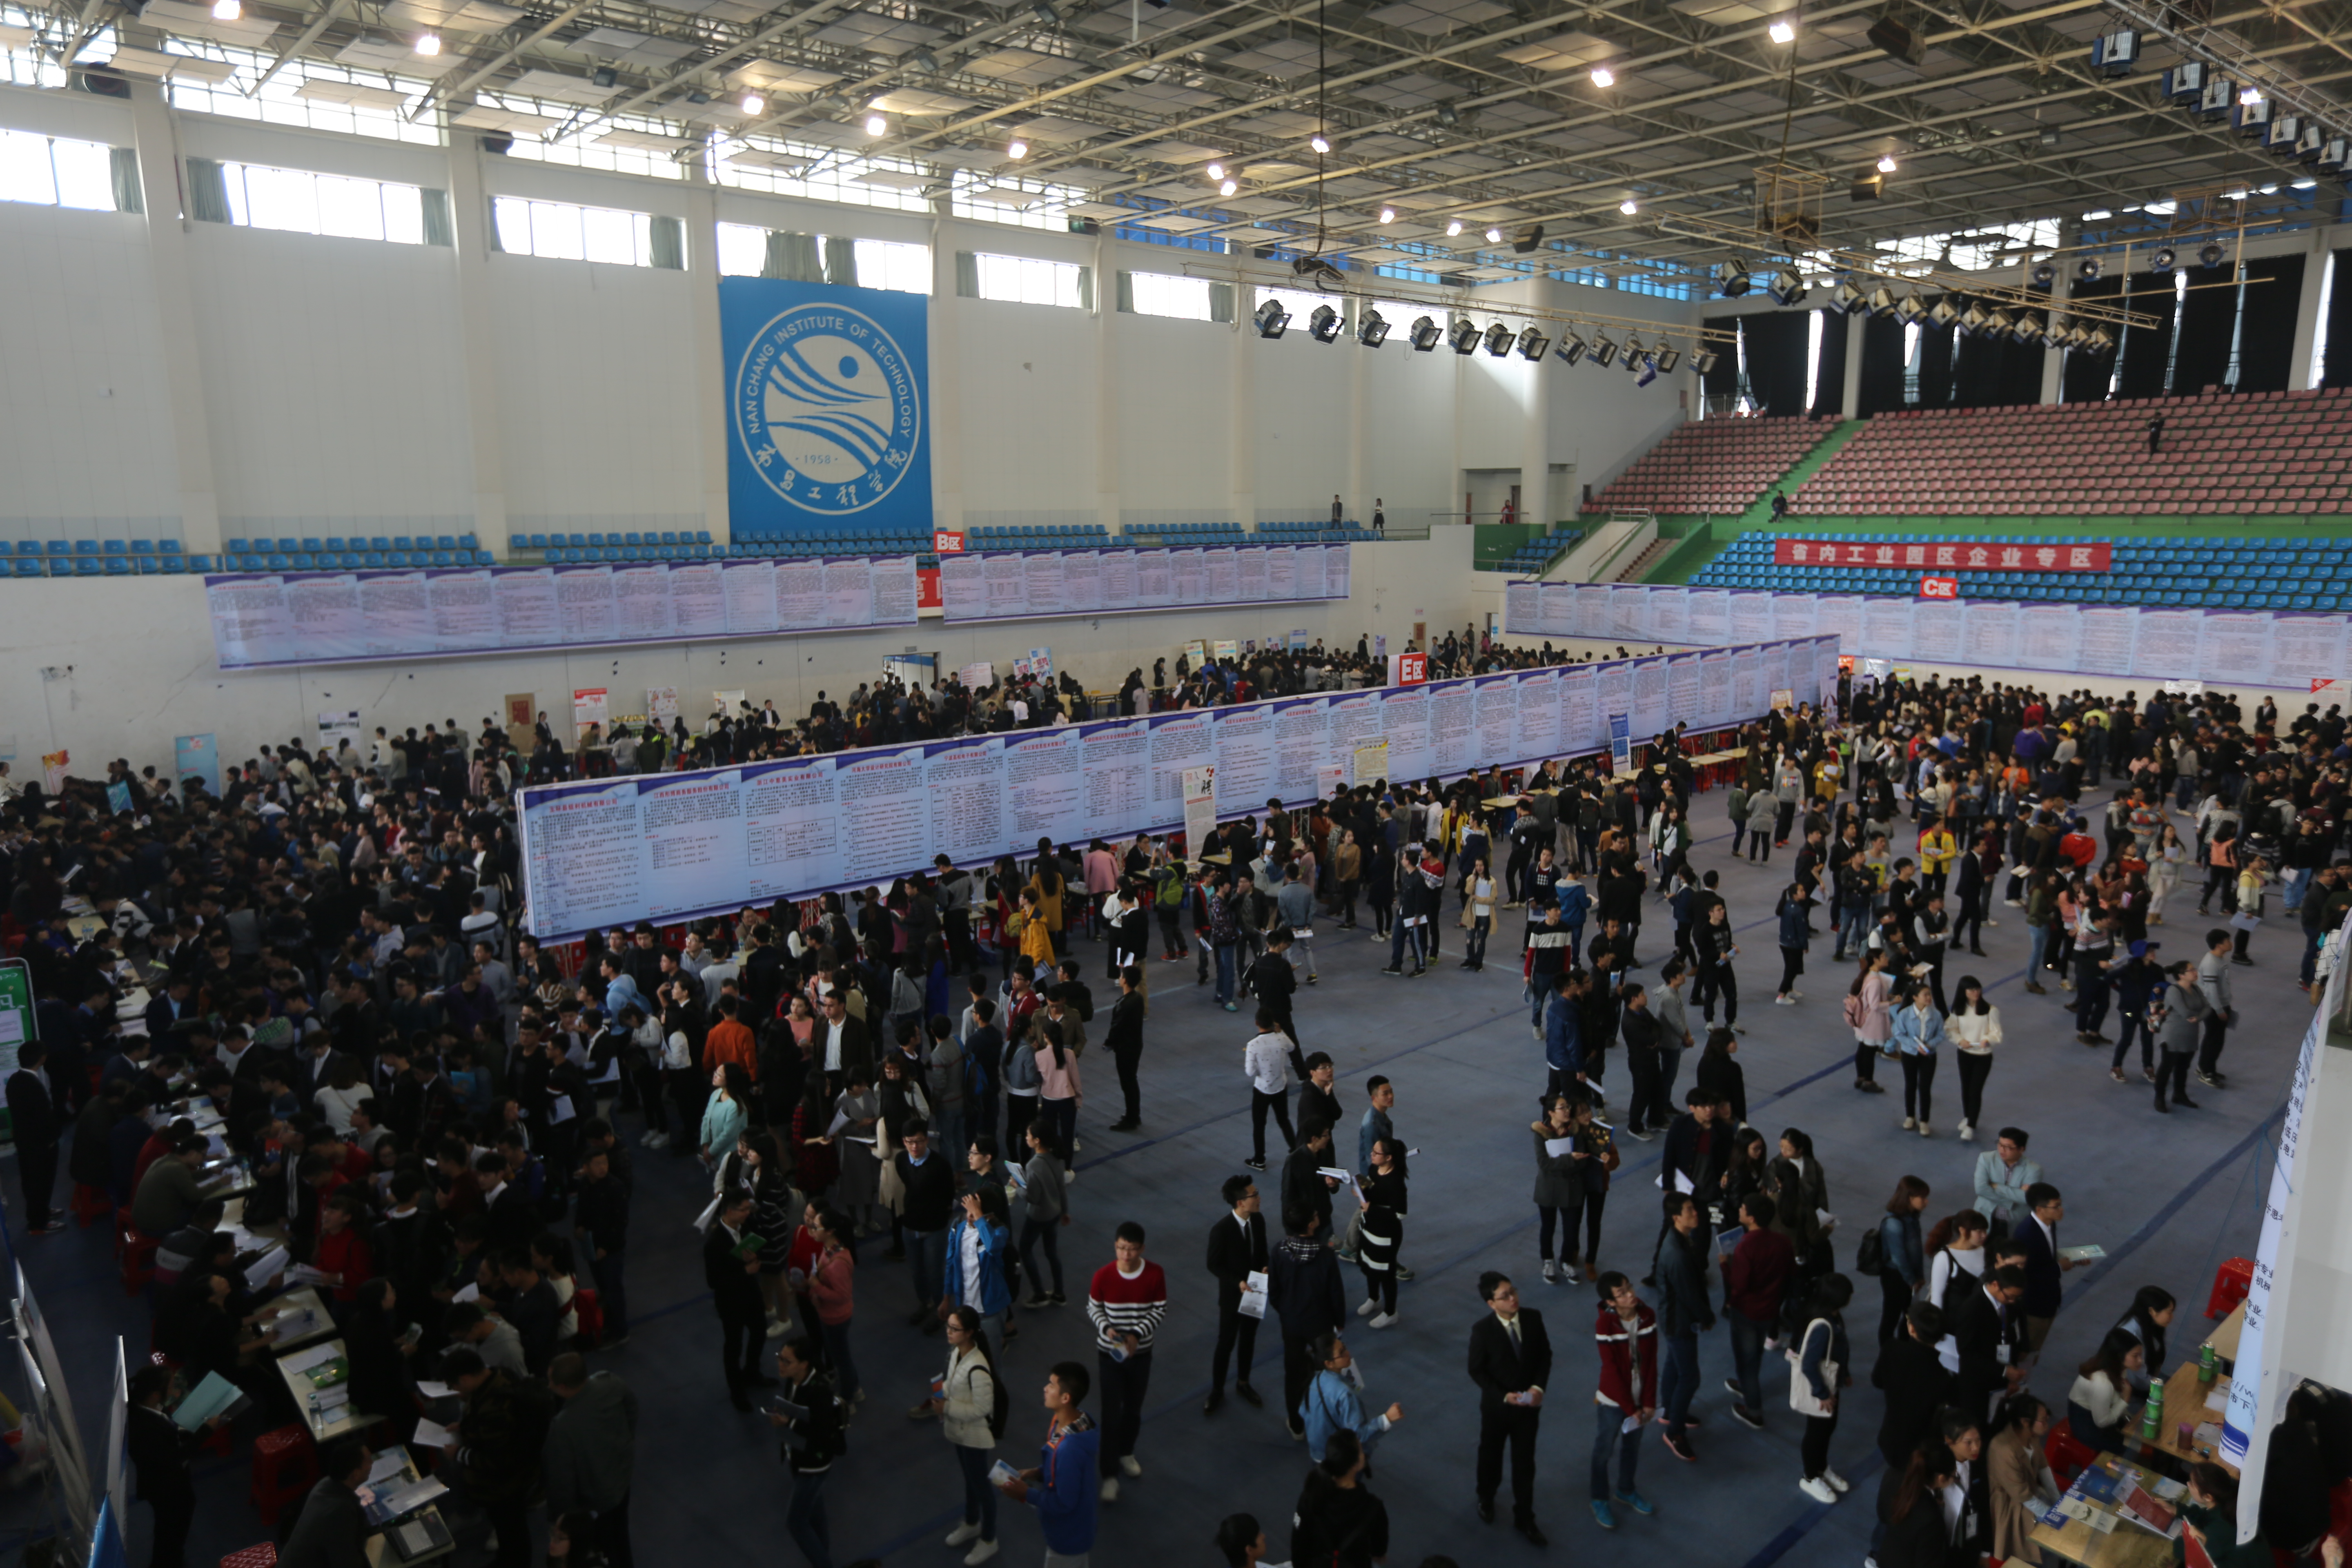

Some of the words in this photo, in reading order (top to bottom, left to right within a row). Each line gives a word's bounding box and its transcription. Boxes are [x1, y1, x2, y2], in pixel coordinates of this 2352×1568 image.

[774, 315, 844, 346] INSTITUTE
[849, 323, 870, 340] OF
[746, 343, 775, 397] CHANG
[871, 337, 914, 439] TECHNOLOGY
[745, 399, 761, 435] NAN
[803, 454, 831, 464] 1958
[937, 533, 961, 550] B区
[1791, 543, 2092, 568] 省内工业园区企业专区
[1923, 578, 1952, 597] C区
[1401, 658, 1424, 682] E区
[852, 760, 912, 773] 河海大学设计研究院有限公司
